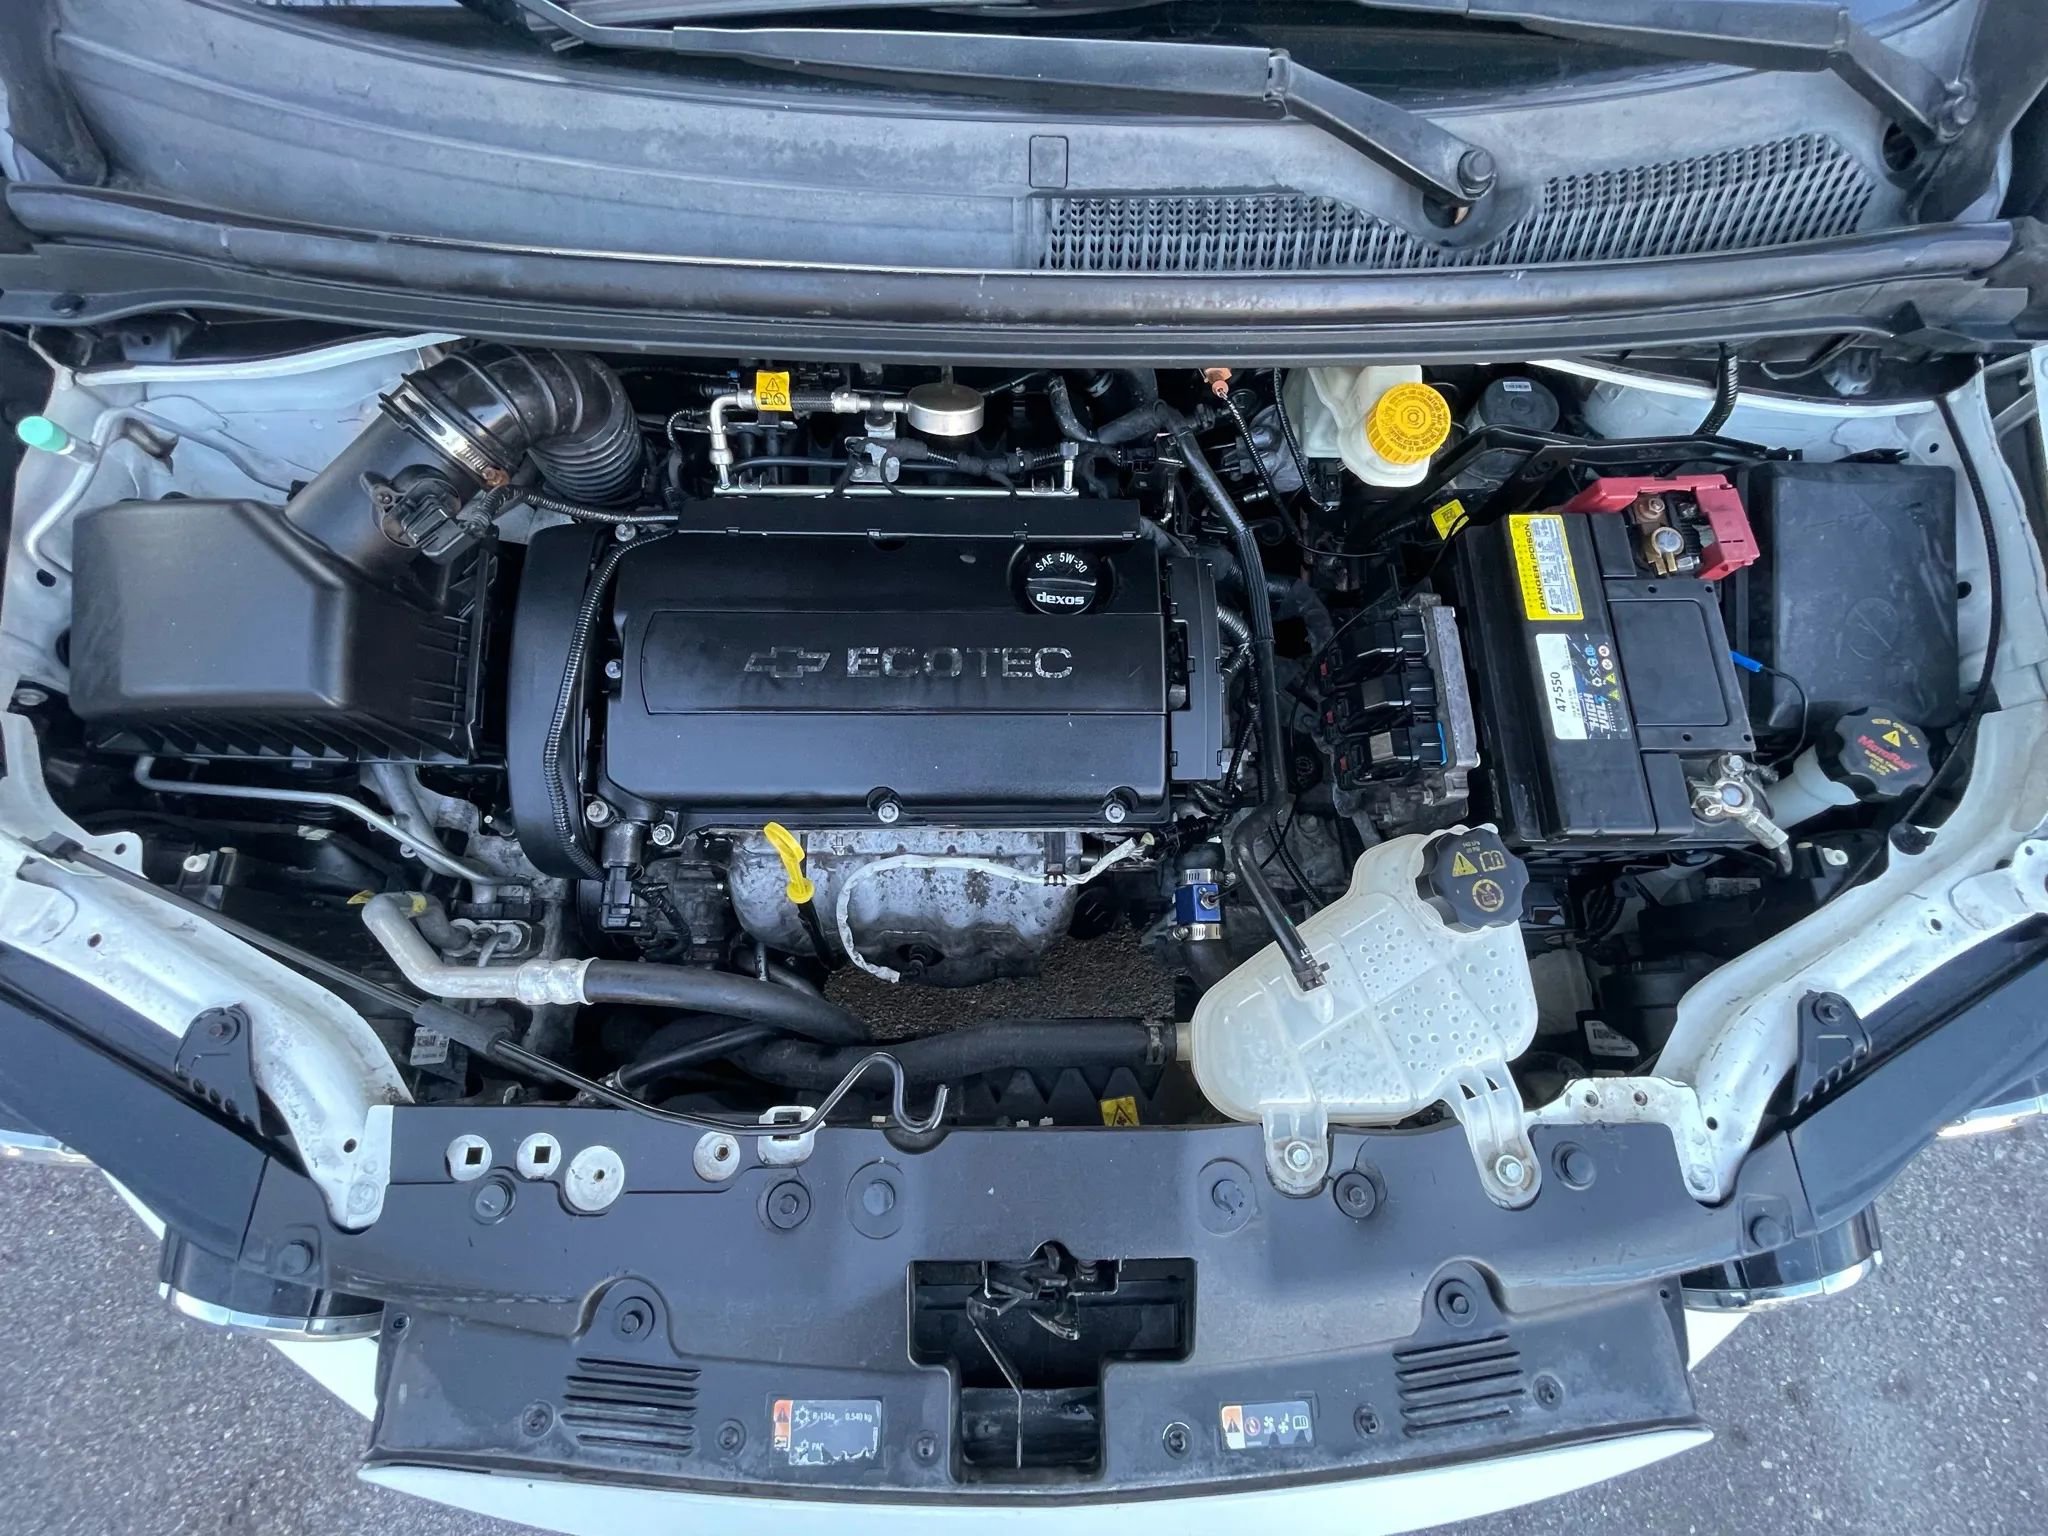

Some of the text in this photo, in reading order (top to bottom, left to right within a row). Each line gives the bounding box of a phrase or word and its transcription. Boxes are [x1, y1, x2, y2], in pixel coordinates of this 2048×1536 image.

[1035, 552, 1088, 573] SAE 5W-30
[1036, 591, 1085, 605] dexos
[847, 647, 1073, 678] ECOTEC
[1550, 671, 1567, 713] 47-550
[1583, 692, 1601, 732] HIGH
